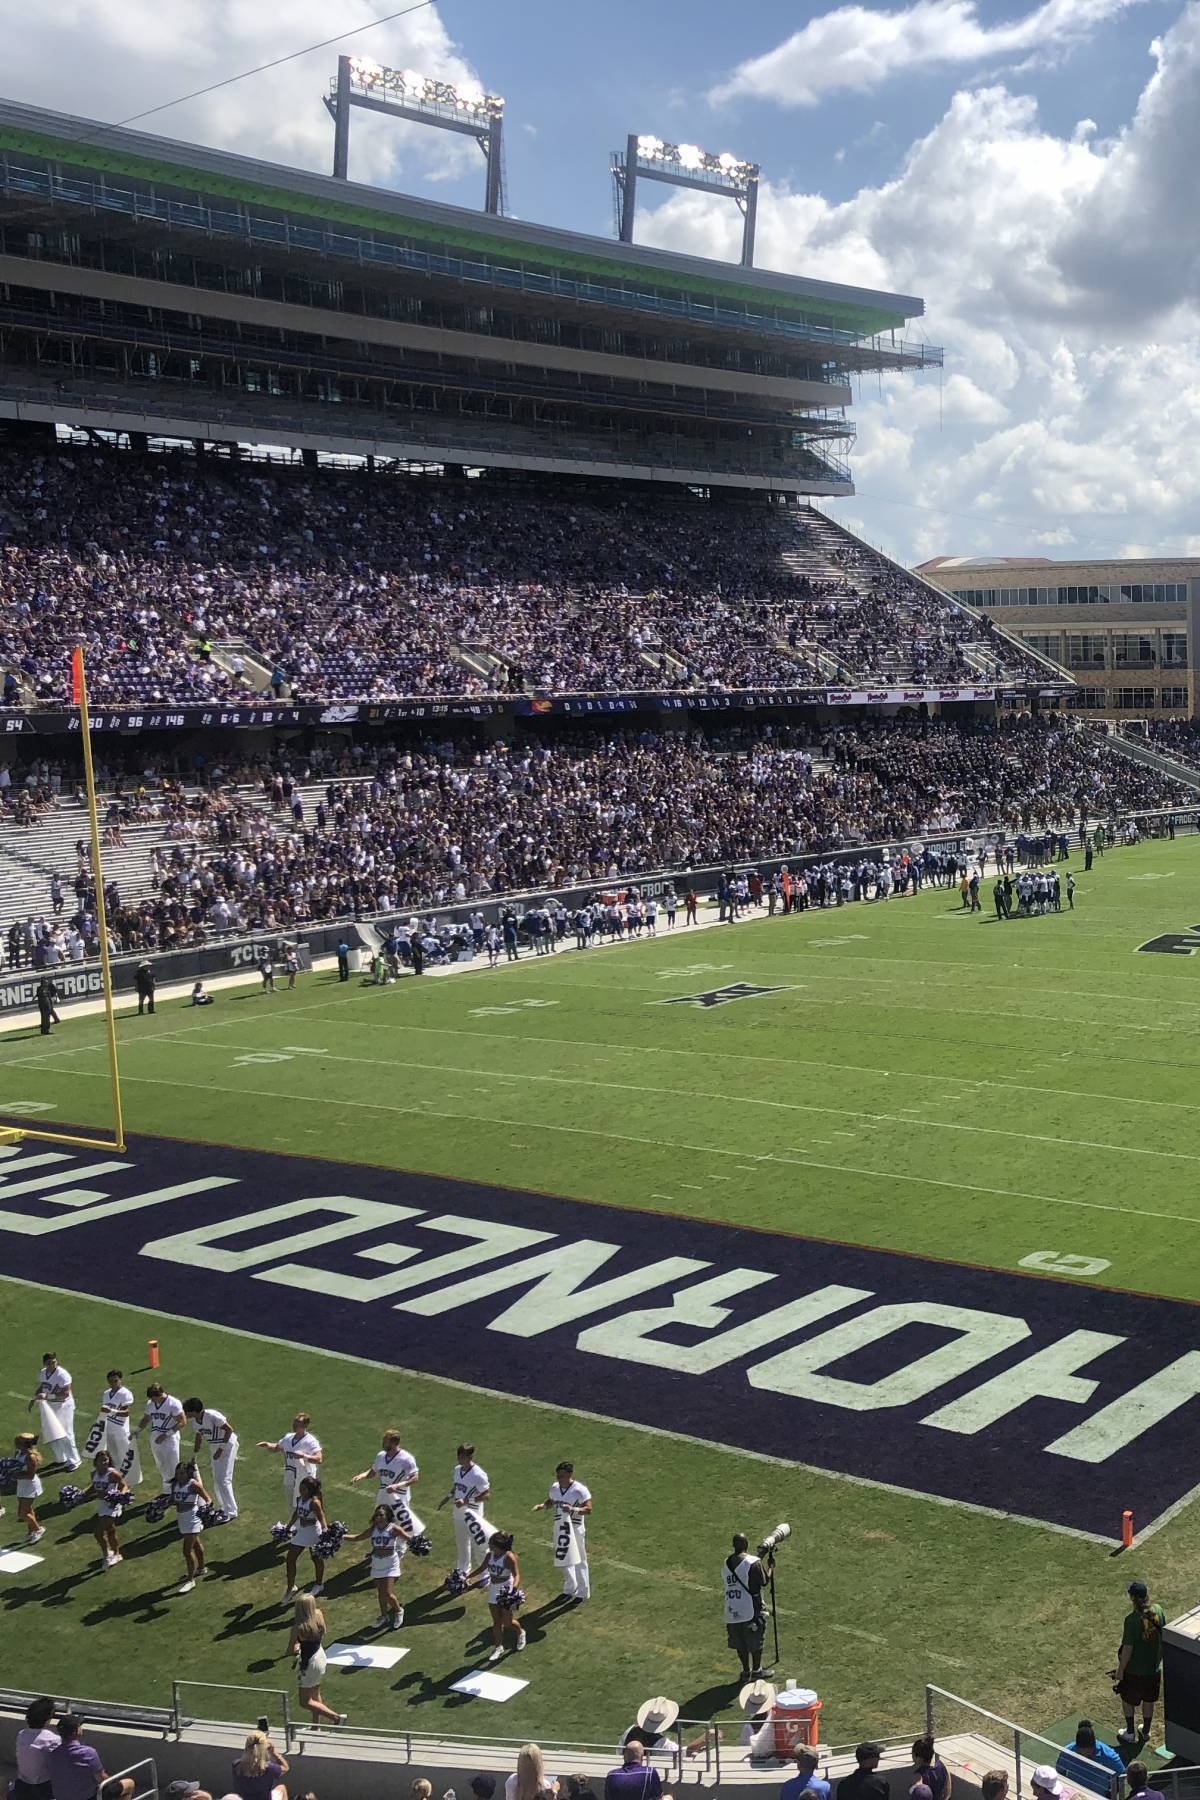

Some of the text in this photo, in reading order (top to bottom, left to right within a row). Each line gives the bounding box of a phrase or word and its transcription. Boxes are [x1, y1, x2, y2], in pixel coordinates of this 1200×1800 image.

[262, 712, 273, 722] 12
[292, 711, 299, 720] 4
[416, 708, 425, 716] 10
[128, 716, 144, 728] 96
[166, 715, 185, 726] 146
[220, 713, 240, 723] 6/6
[6, 719, 24, 732] 54
[85, 1420, 106, 1453] TCU
[379, 1468, 396, 1479] TCU
[464, 1511, 487, 1546] TCU
[555, 1521, 570, 1560] TCU
